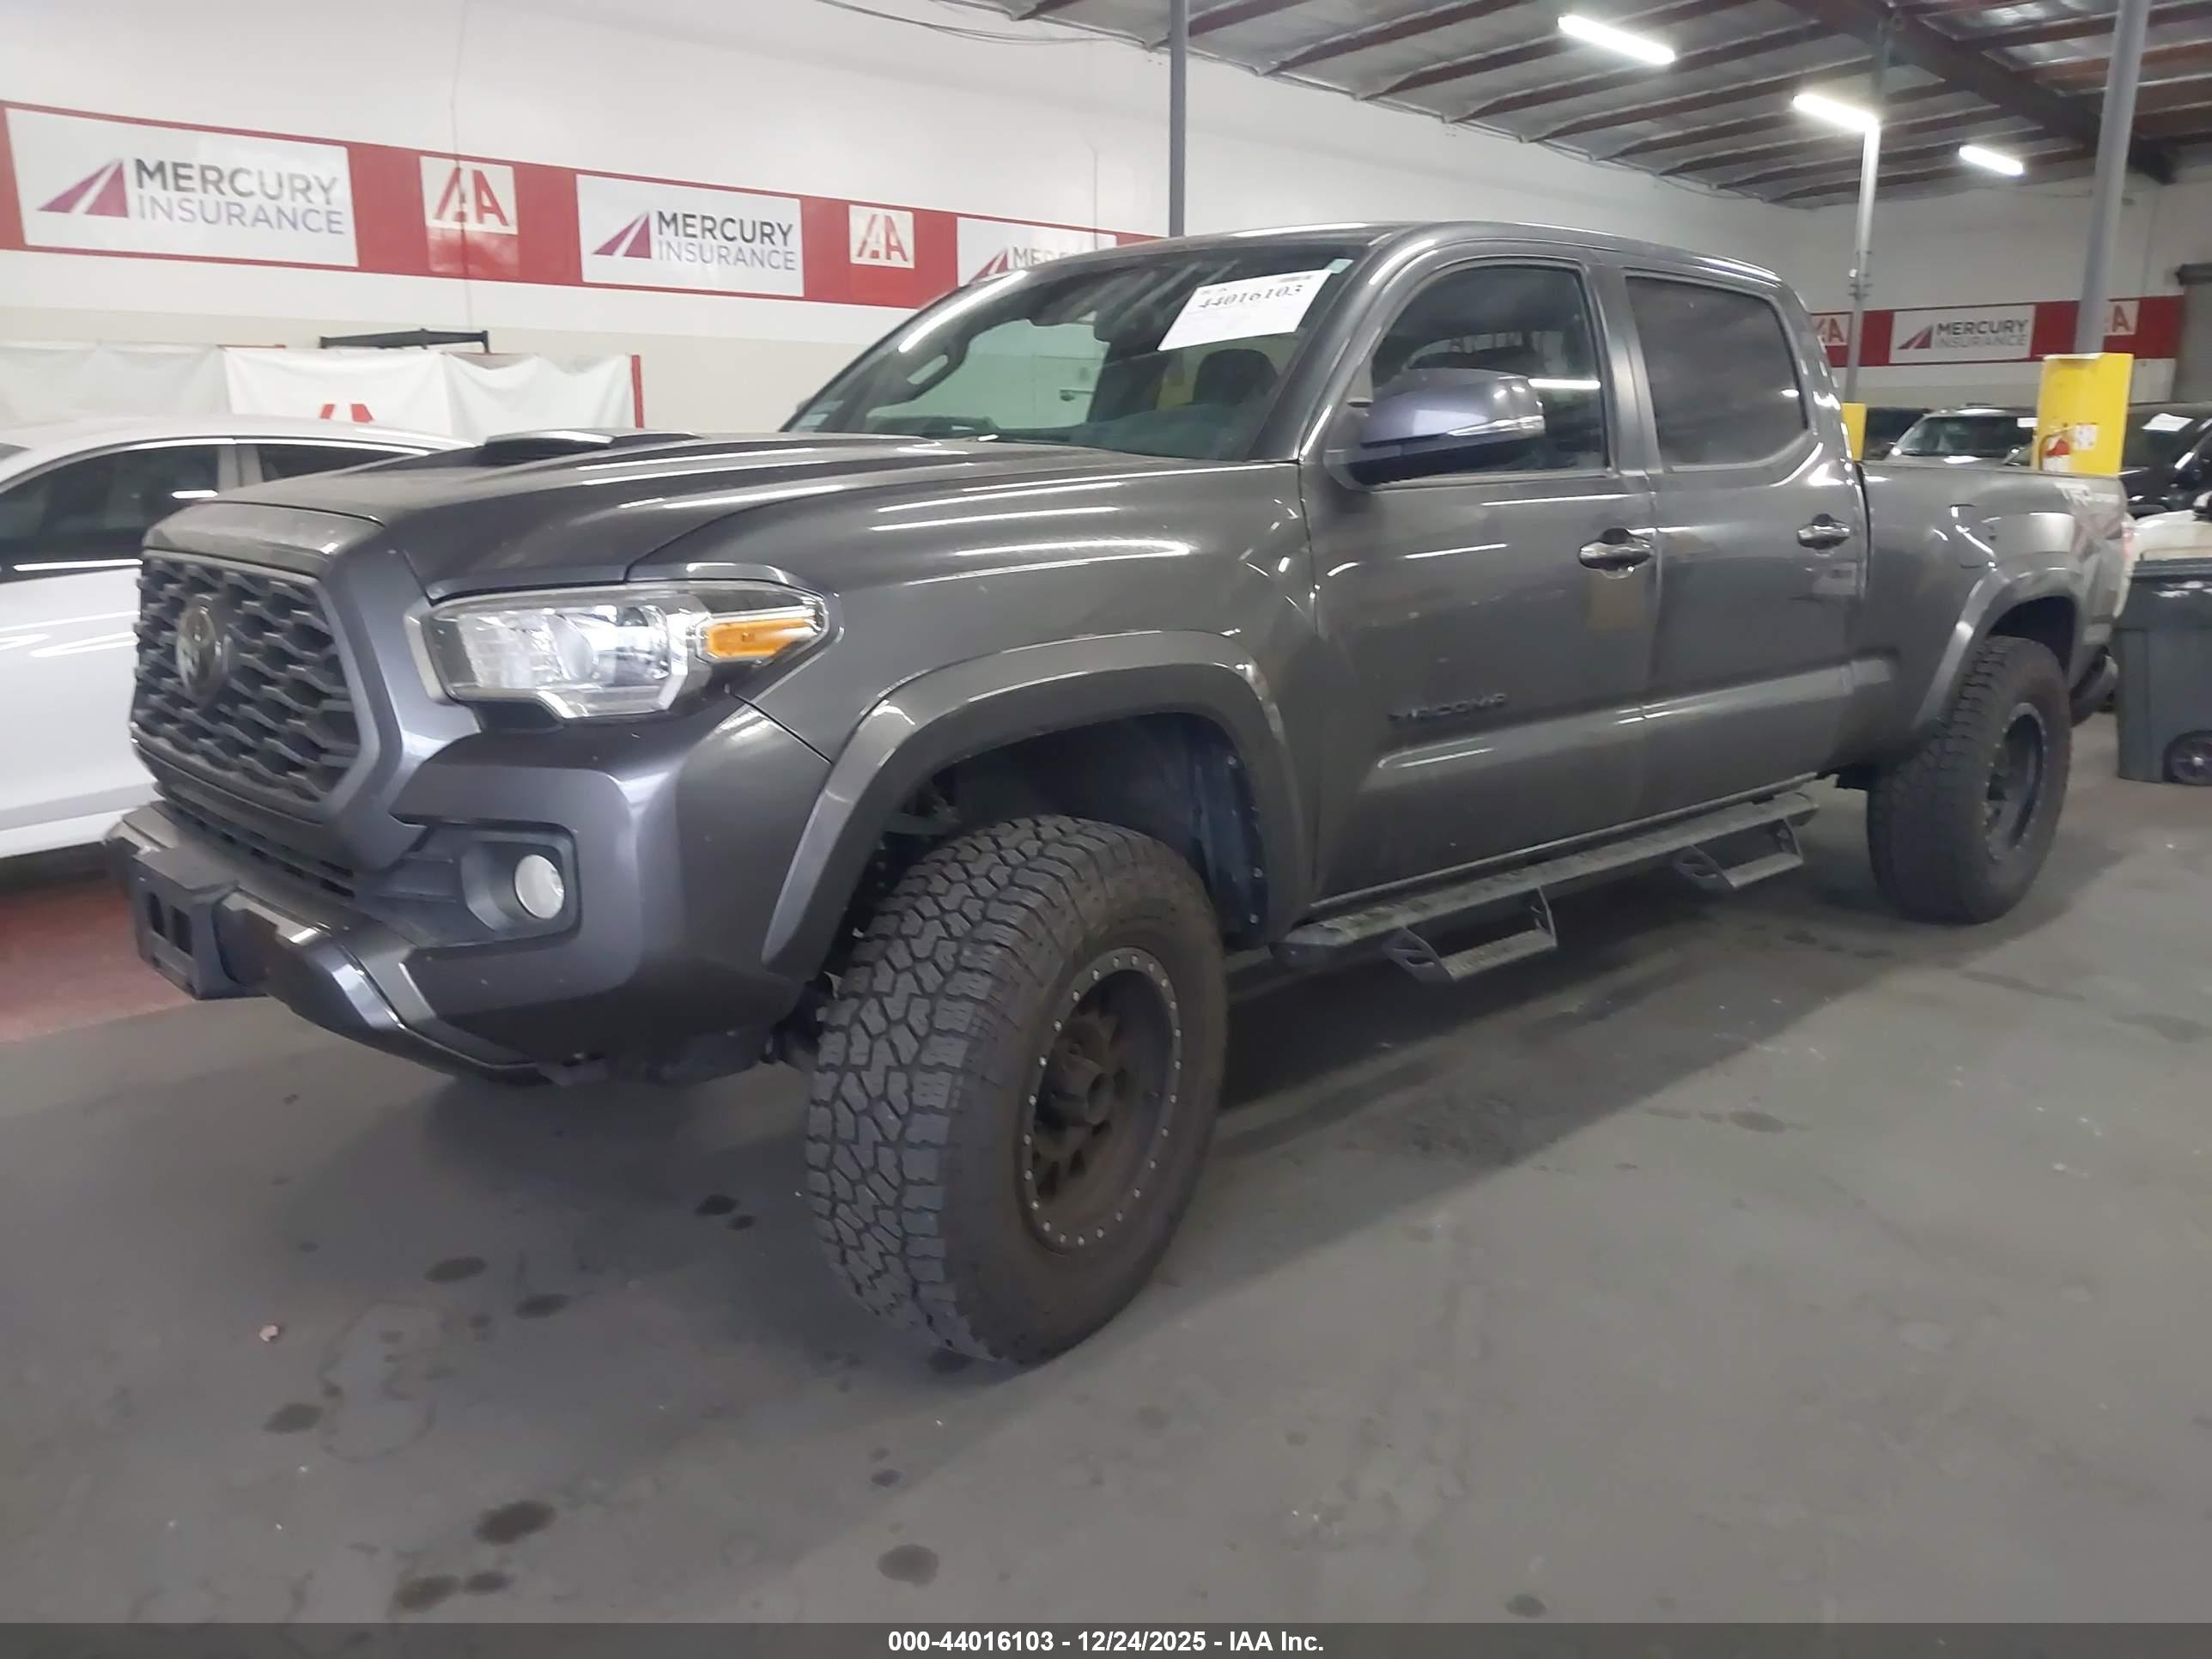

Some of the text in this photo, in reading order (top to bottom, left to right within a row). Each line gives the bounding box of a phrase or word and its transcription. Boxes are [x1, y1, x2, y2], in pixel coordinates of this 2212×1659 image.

[134, 157, 340, 206] MERCURY
[137, 194, 346, 235] INSURANCE
[656, 209, 794, 246] MERCURY
[658, 240, 797, 271] INSURANCE
[1936, 319, 2029, 336] MERCURY
